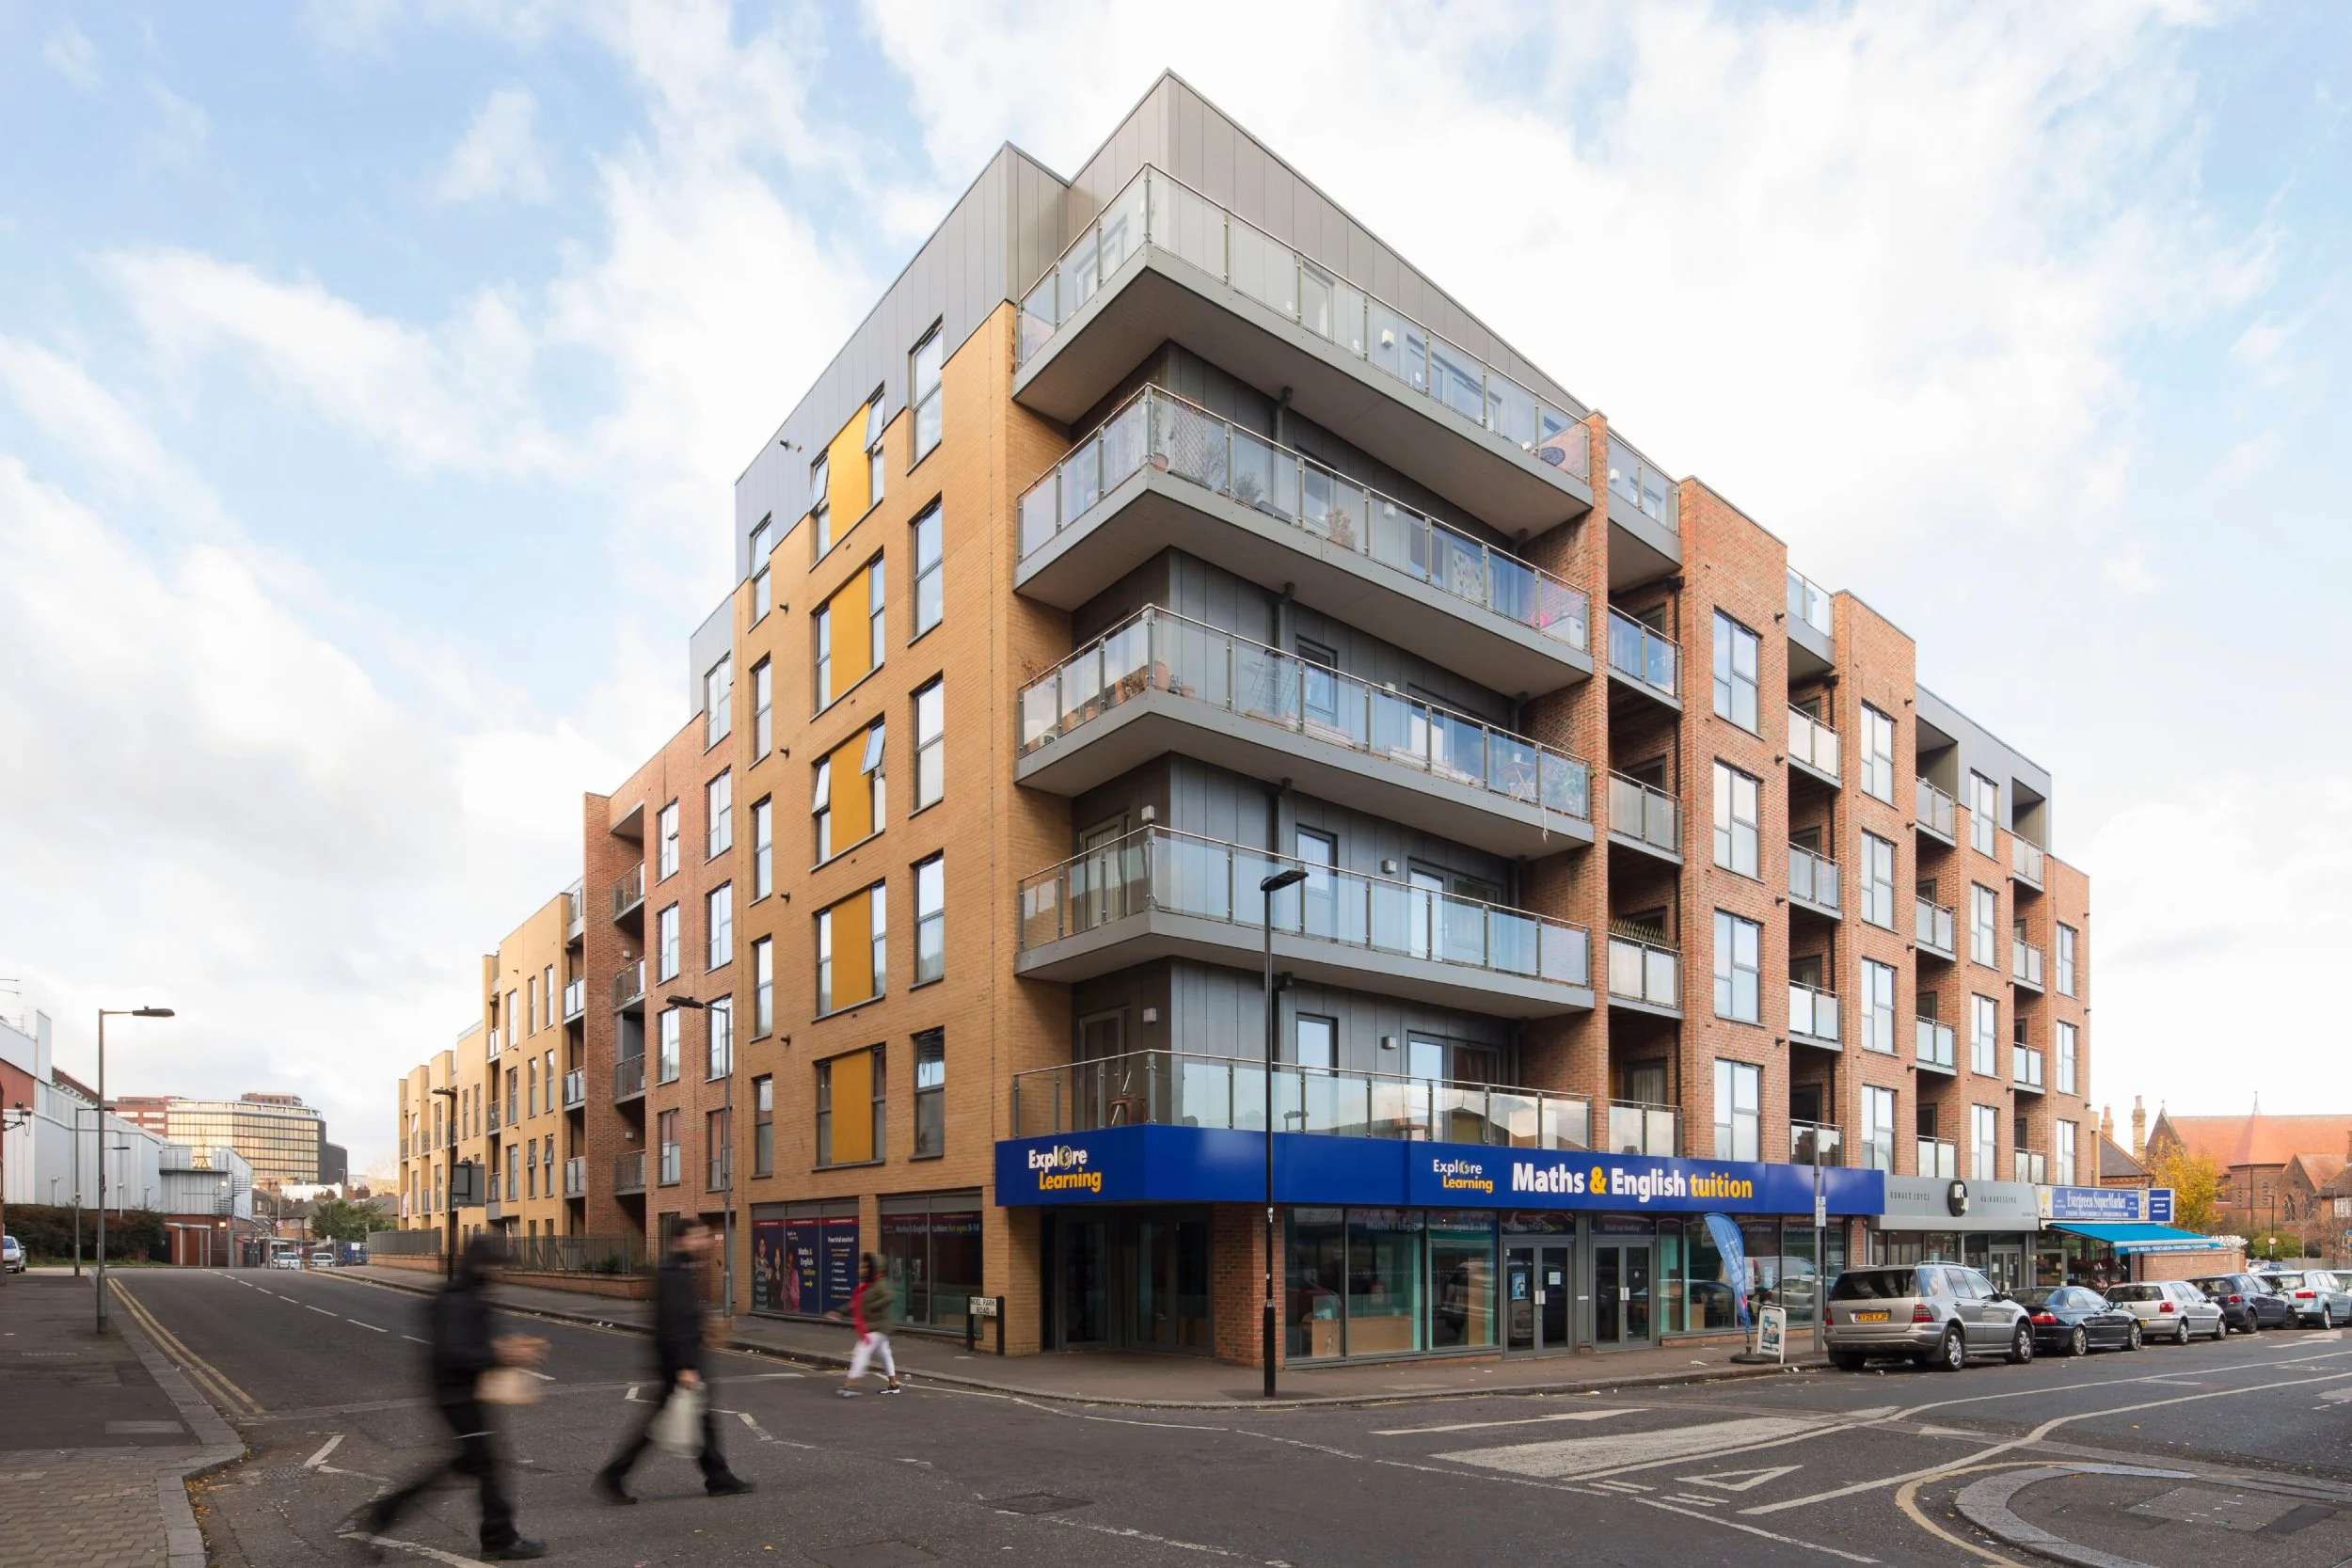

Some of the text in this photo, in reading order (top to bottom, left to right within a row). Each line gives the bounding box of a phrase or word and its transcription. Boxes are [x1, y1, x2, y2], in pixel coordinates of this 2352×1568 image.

[1029, 1145, 1088, 1173] Explore
[1433, 1159, 1483, 1177] Explore
[1040, 1166, 1102, 1193] Learning
[1442, 1175, 1493, 1194] Learning
[1512, 1163, 1753, 1203] Maths & English tuition
[977, 1307, 990, 1315] ROAD
